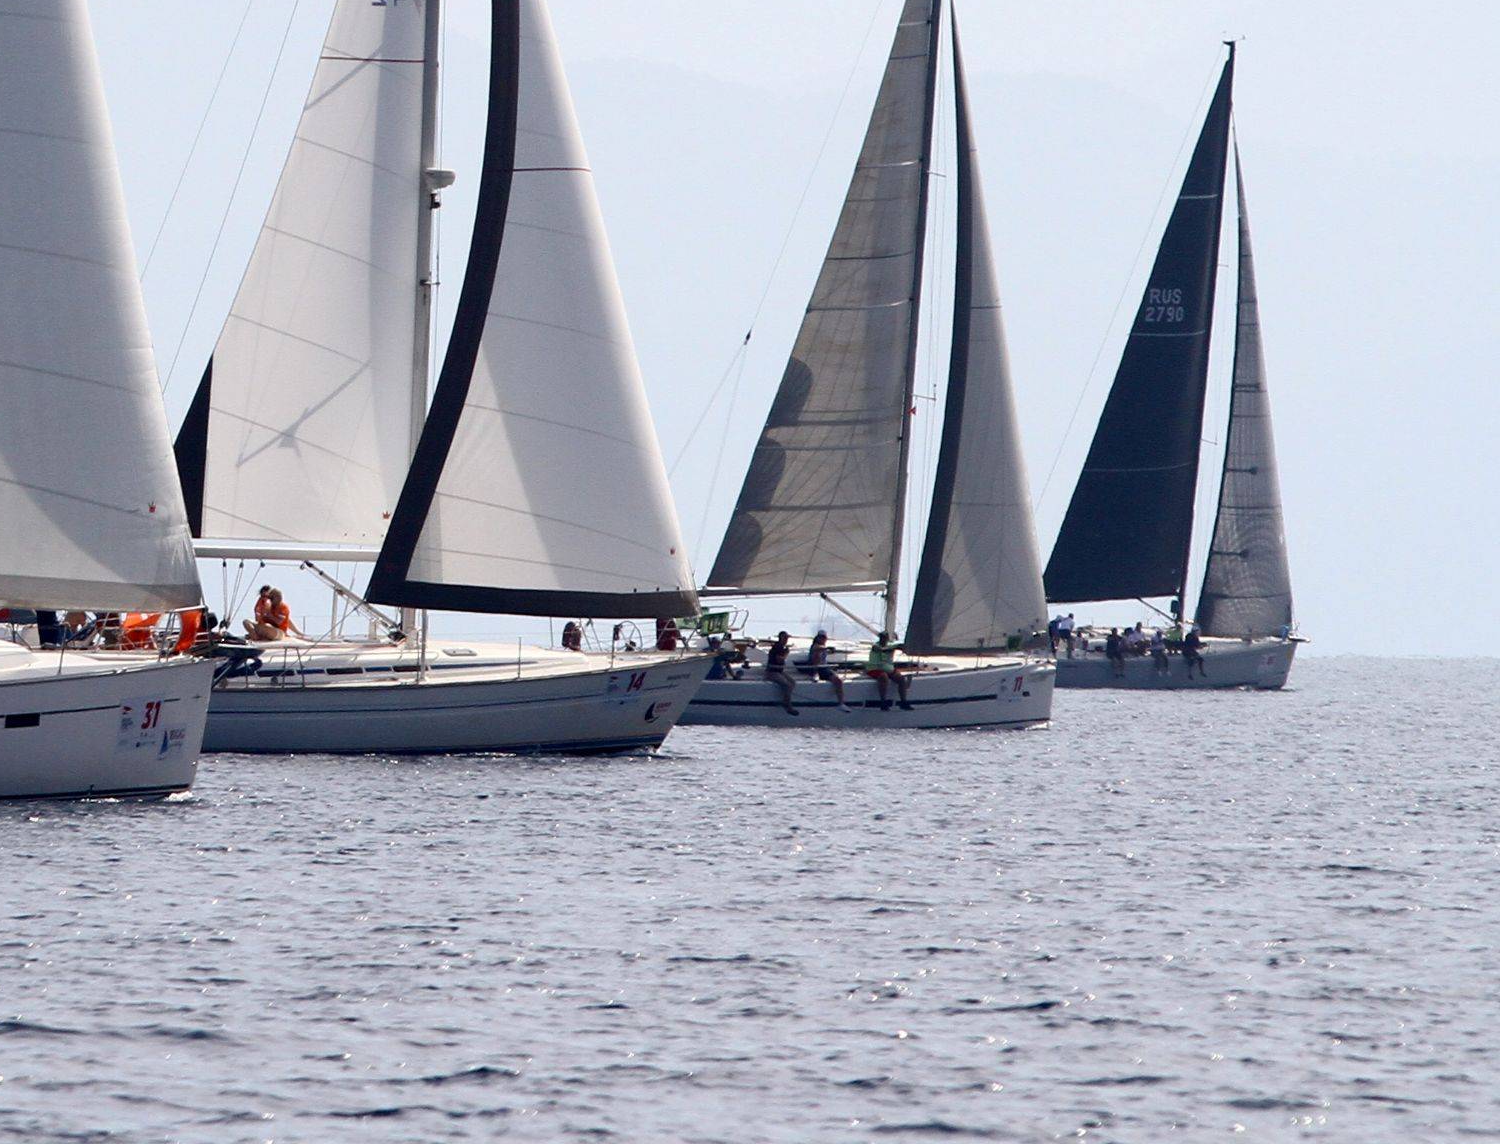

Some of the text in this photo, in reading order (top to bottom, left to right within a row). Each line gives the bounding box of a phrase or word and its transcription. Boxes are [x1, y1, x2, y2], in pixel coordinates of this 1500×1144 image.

[1150, 288, 1182, 304] RUS
[1145, 307, 1184, 322] 2790
[627, 671, 647, 693] 14
[141, 701, 162, 729] 31
